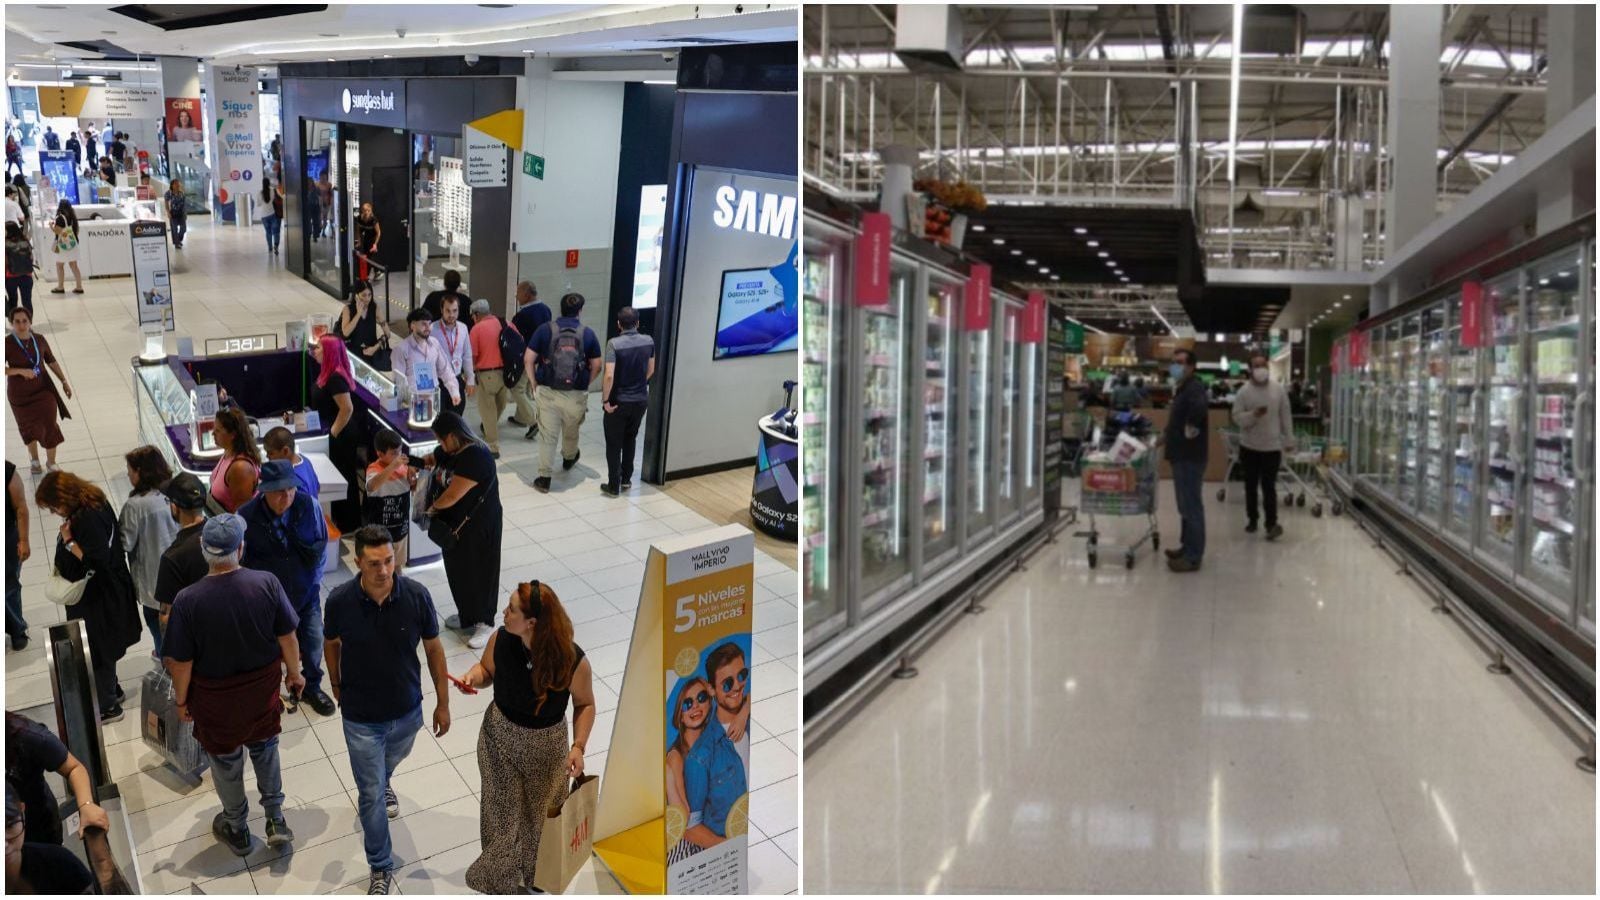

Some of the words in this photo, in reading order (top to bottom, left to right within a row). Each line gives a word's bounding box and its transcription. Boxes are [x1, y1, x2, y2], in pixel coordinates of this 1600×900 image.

[172, 101, 193, 110] CINE
[222, 100, 253, 113] Sigue
[352, 89, 381, 114] sunglass
[381, 89, 394, 110] hut
[228, 110, 248, 118] nos
[225, 133, 253, 142] @Mall
[227, 141, 252, 150] Vivo
[224, 149, 255, 158] Imperio
[713, 185, 797, 240] SAM
[757, 502, 786, 521] Galaxy
[692, 550, 710, 562] MALL
[711, 546, 730, 556] VIVO
[694, 556, 727, 571] IMPERIO
[674, 594, 696, 633] 5
[698, 584, 746, 606] Niveles
